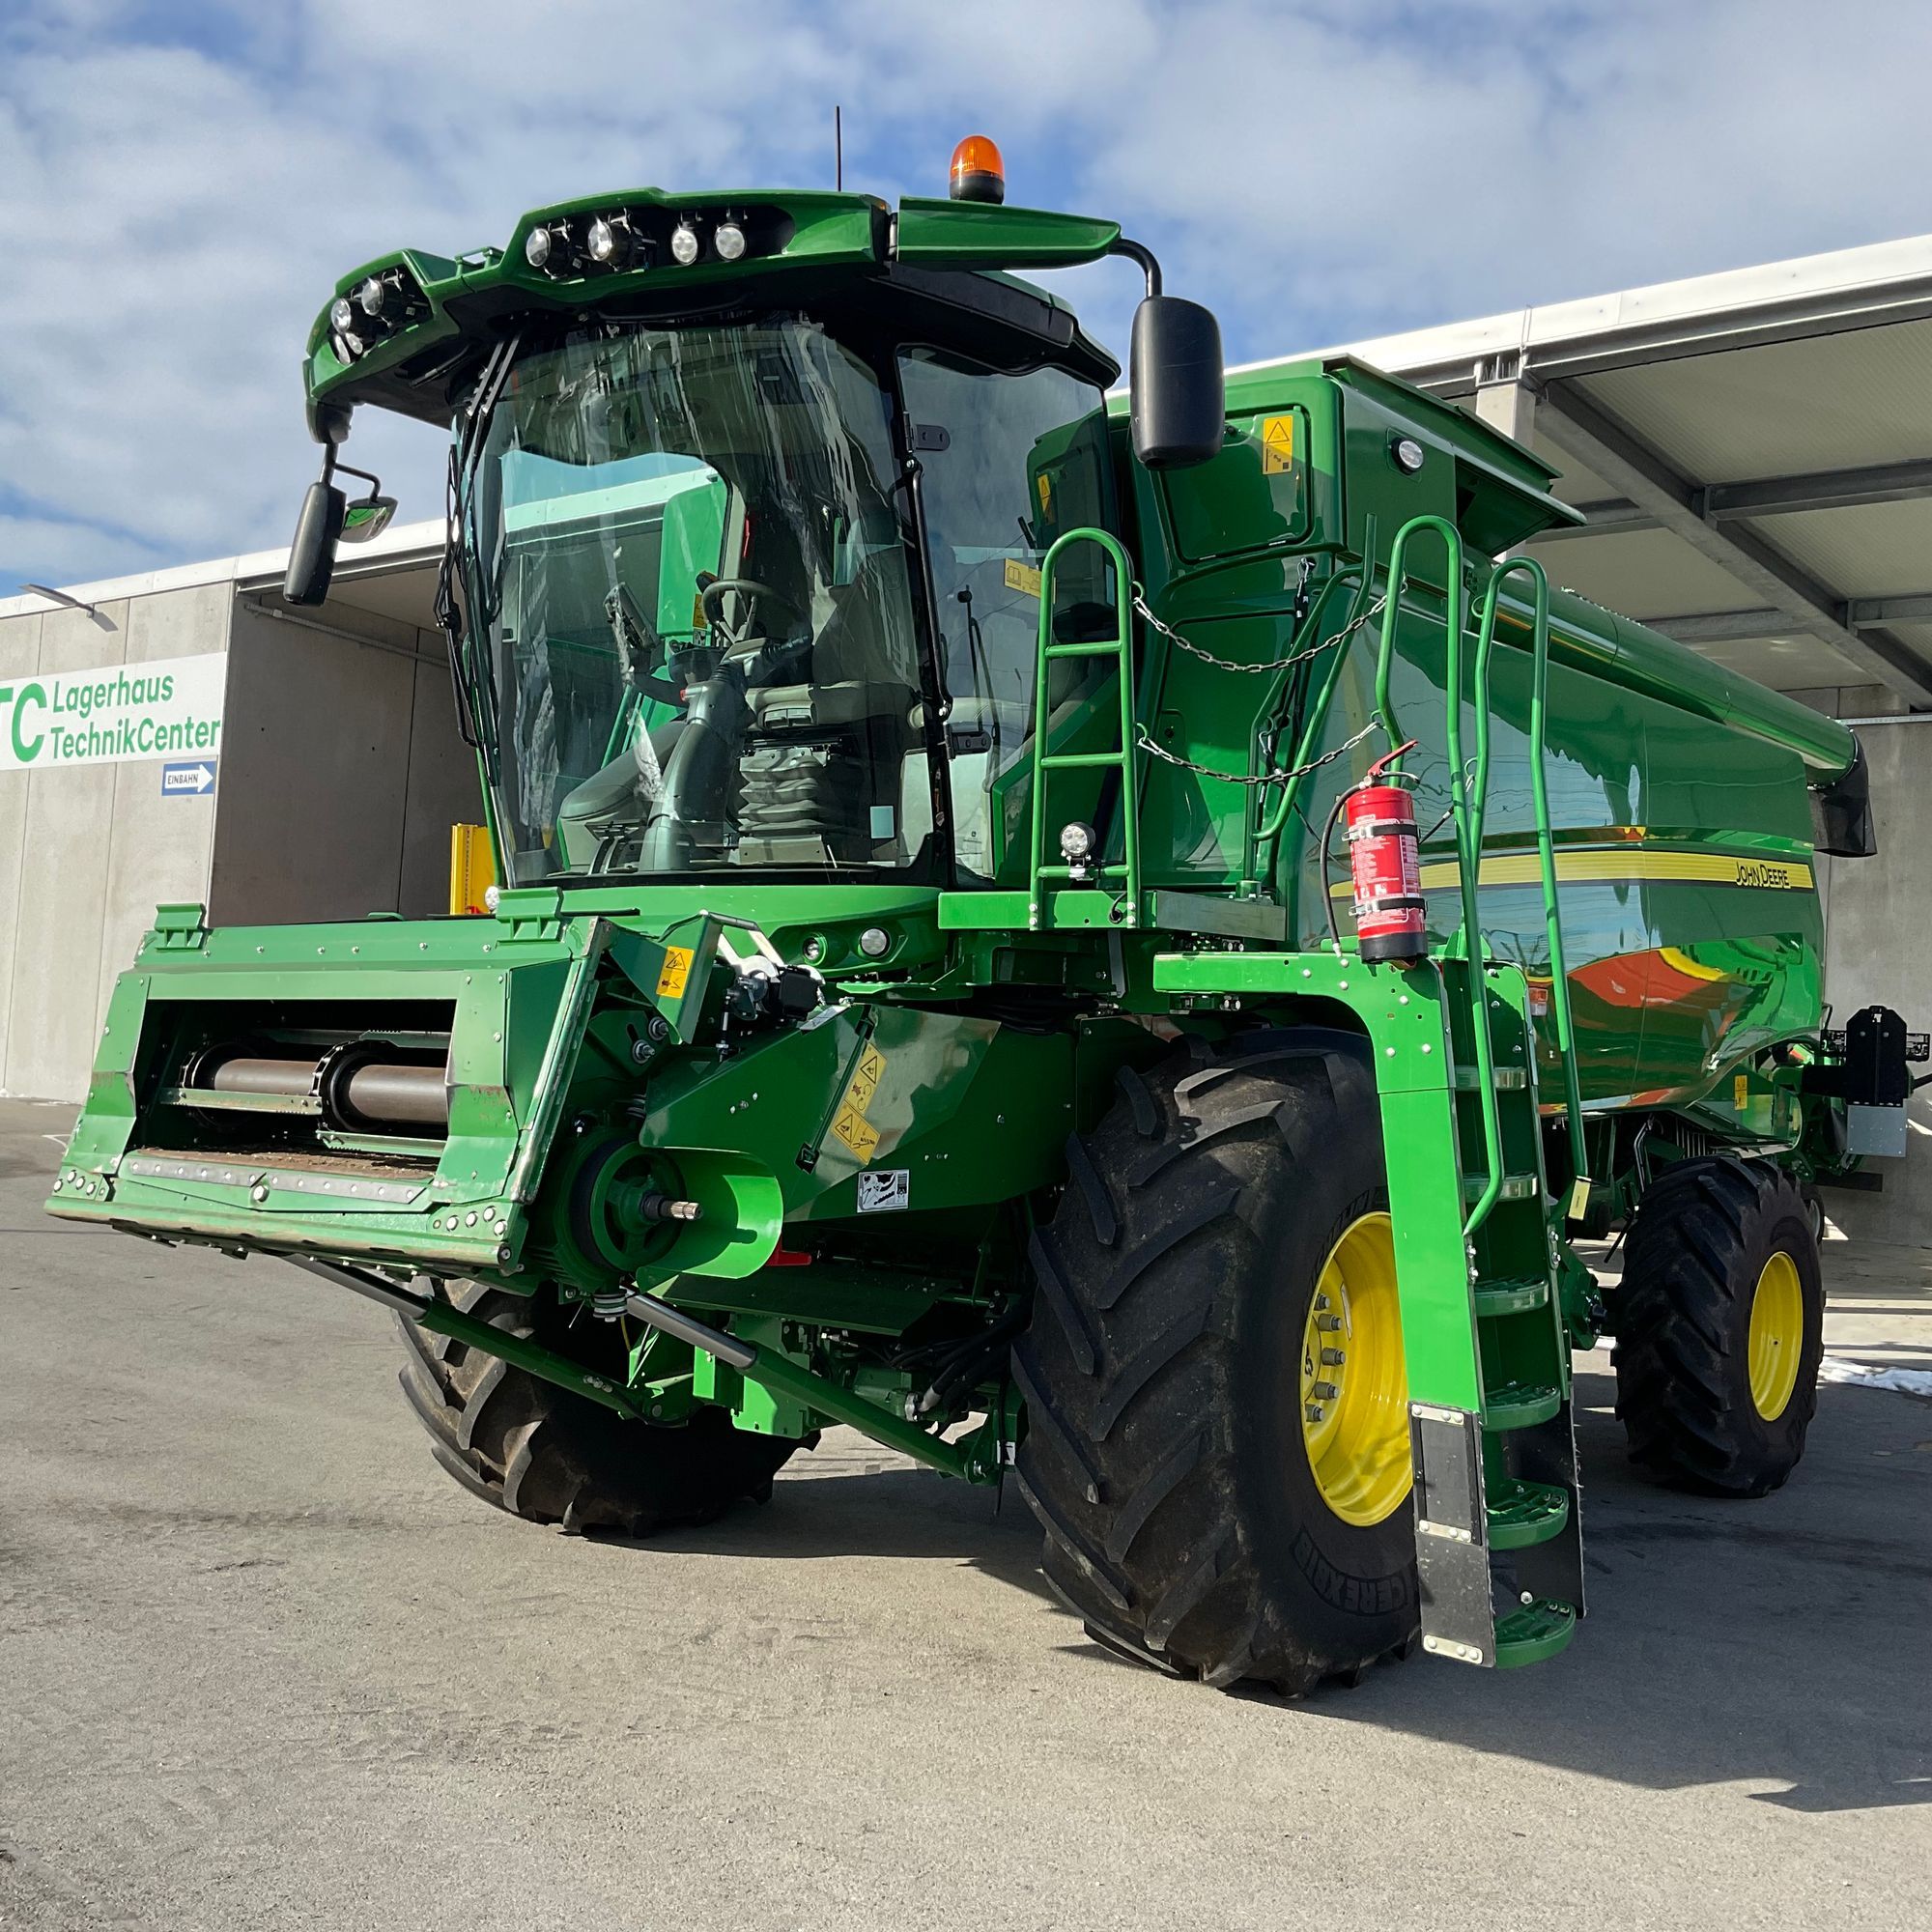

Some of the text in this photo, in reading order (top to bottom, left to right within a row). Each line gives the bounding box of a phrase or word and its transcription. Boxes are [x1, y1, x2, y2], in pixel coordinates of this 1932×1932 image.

[53, 670, 174, 719] Lagerhaus
[51, 716, 221, 759] TechnikCenter
[167, 772, 199, 785] EINBAHN
[1736, 861, 1790, 887] JOHN DEERE
